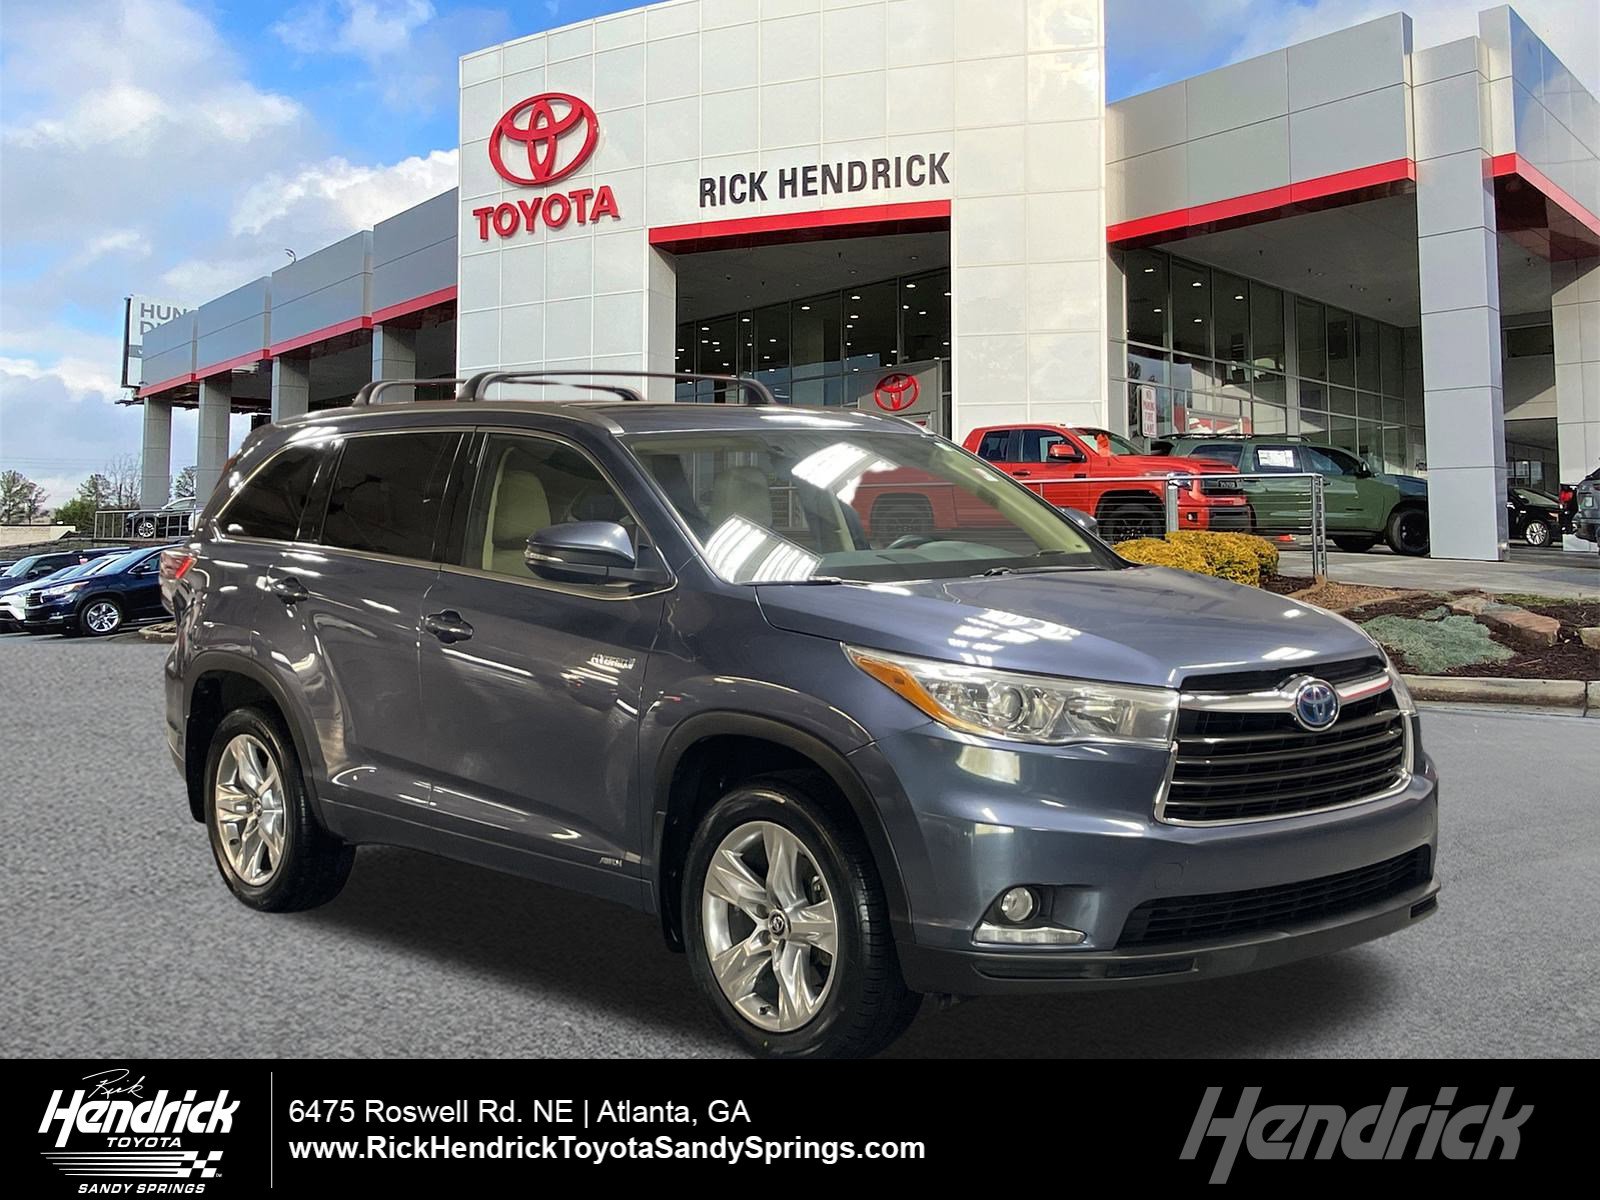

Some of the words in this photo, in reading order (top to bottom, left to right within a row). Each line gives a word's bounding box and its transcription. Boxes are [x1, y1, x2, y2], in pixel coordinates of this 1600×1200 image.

[699, 171, 768, 207] RICK
[779, 152, 951, 199] HENDRICK
[473, 185, 620, 240] TOYOTA
